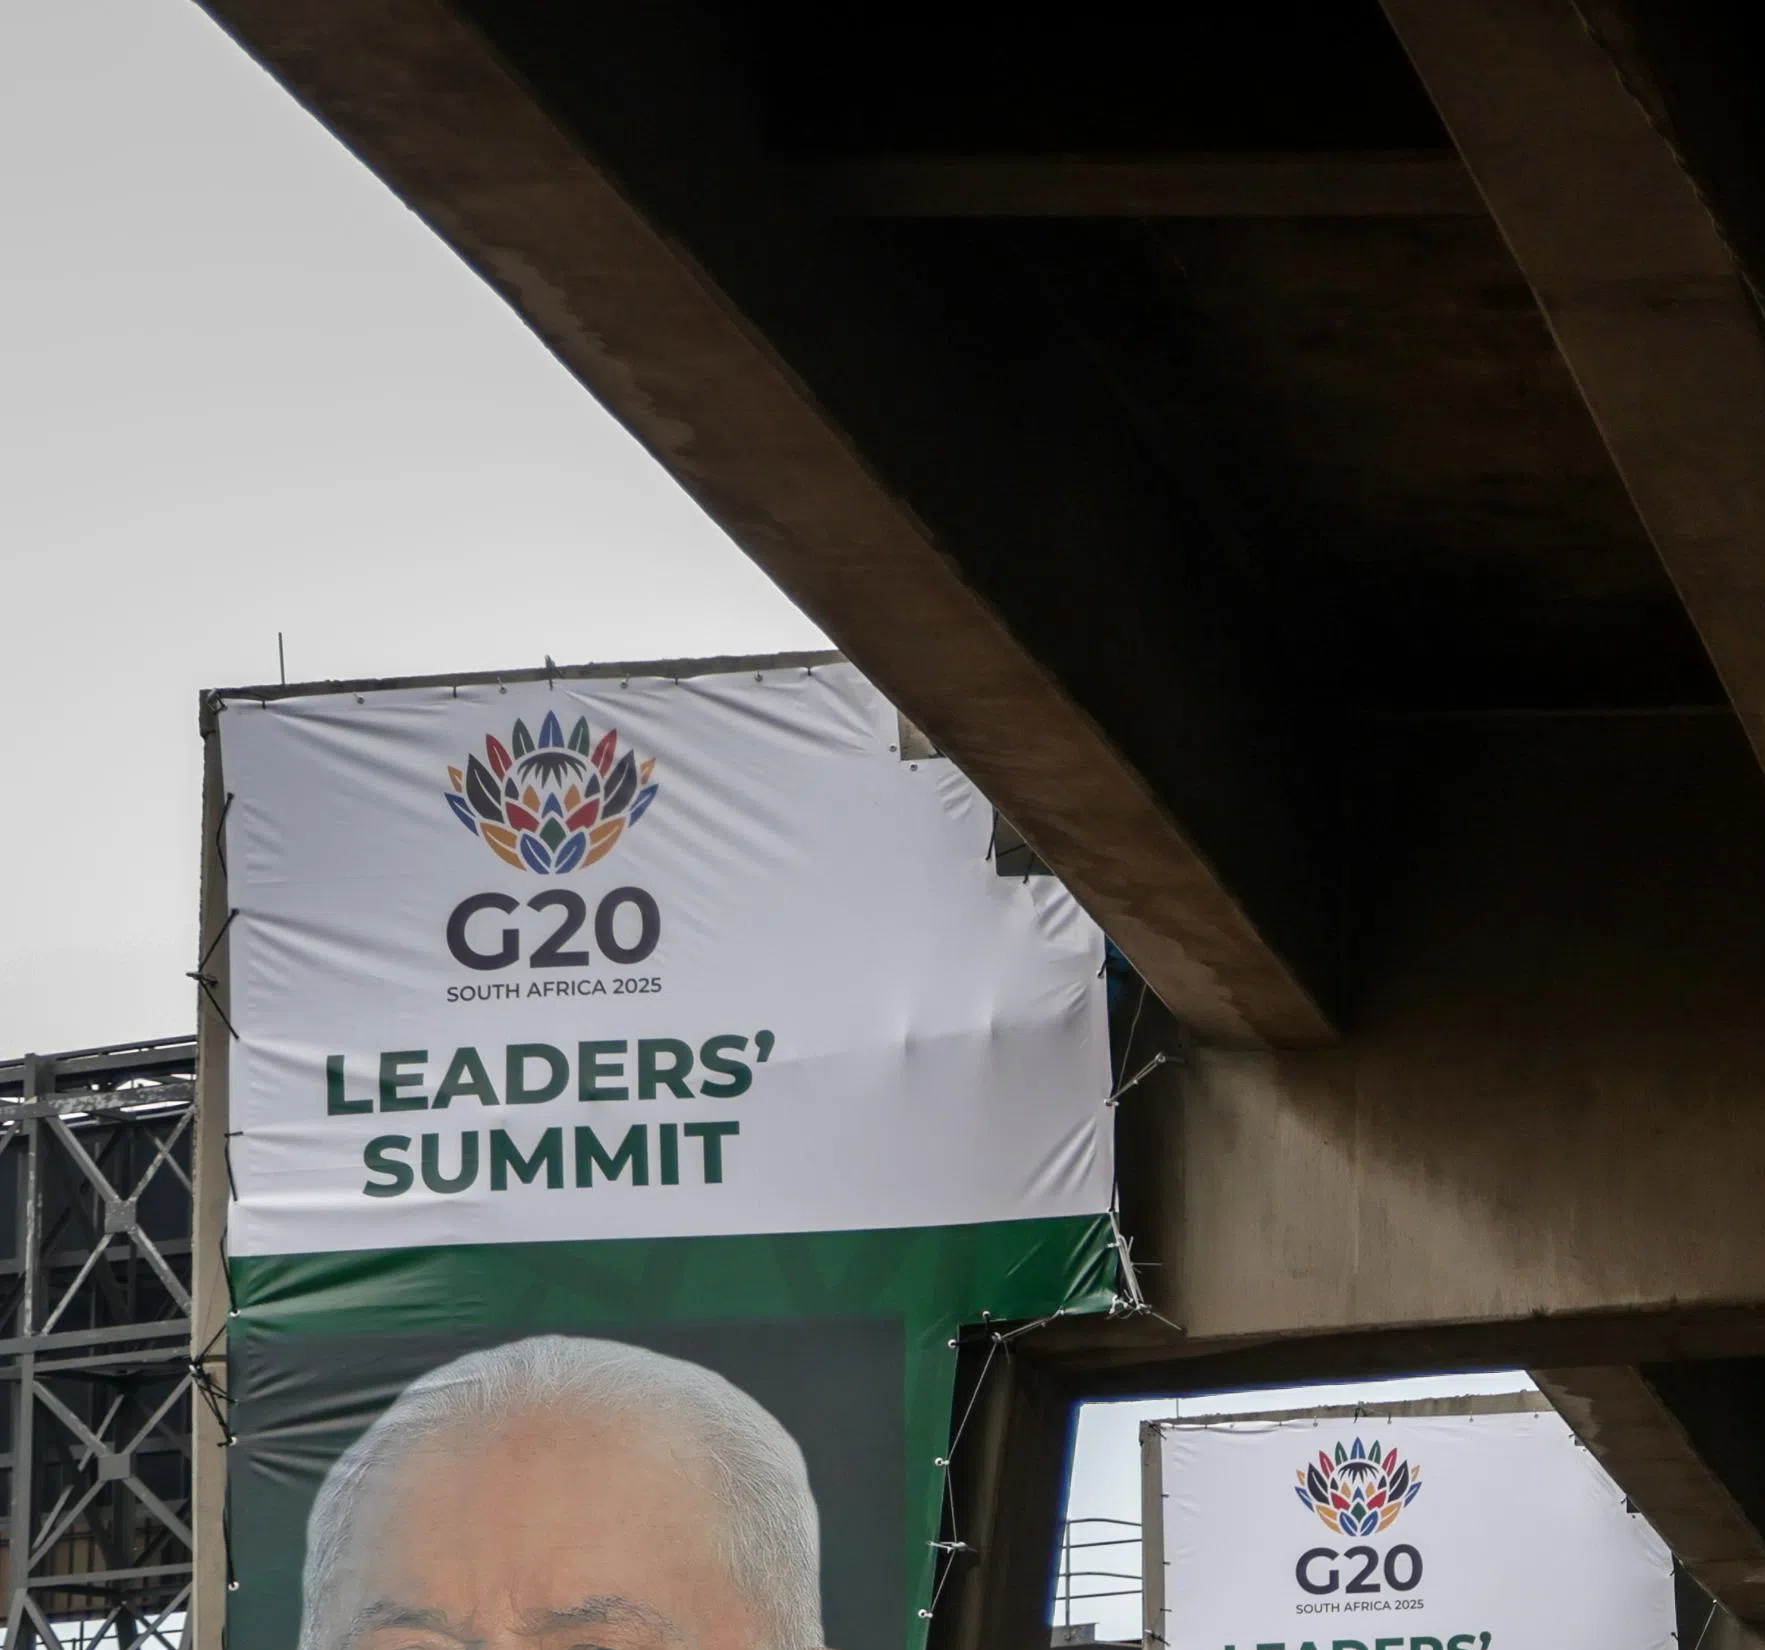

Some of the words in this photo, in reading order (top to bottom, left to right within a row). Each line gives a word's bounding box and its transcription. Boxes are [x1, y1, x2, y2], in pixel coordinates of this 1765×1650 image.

[445, 886, 661, 972] G20
[446, 983, 520, 1002] SOUTH
[527, 980, 607, 997] AFRICA
[613, 977, 662, 994] 2025
[326, 1029, 776, 1115] LEADERS’
[362, 1120, 740, 1197] SUMMIT
[1295, 1544, 1424, 1595] G20
[1296, 1603, 1340, 1615] SOUTH
[1344, 1601, 1391, 1613] AFRICA
[1394, 1599, 1424, 1611] 2025
